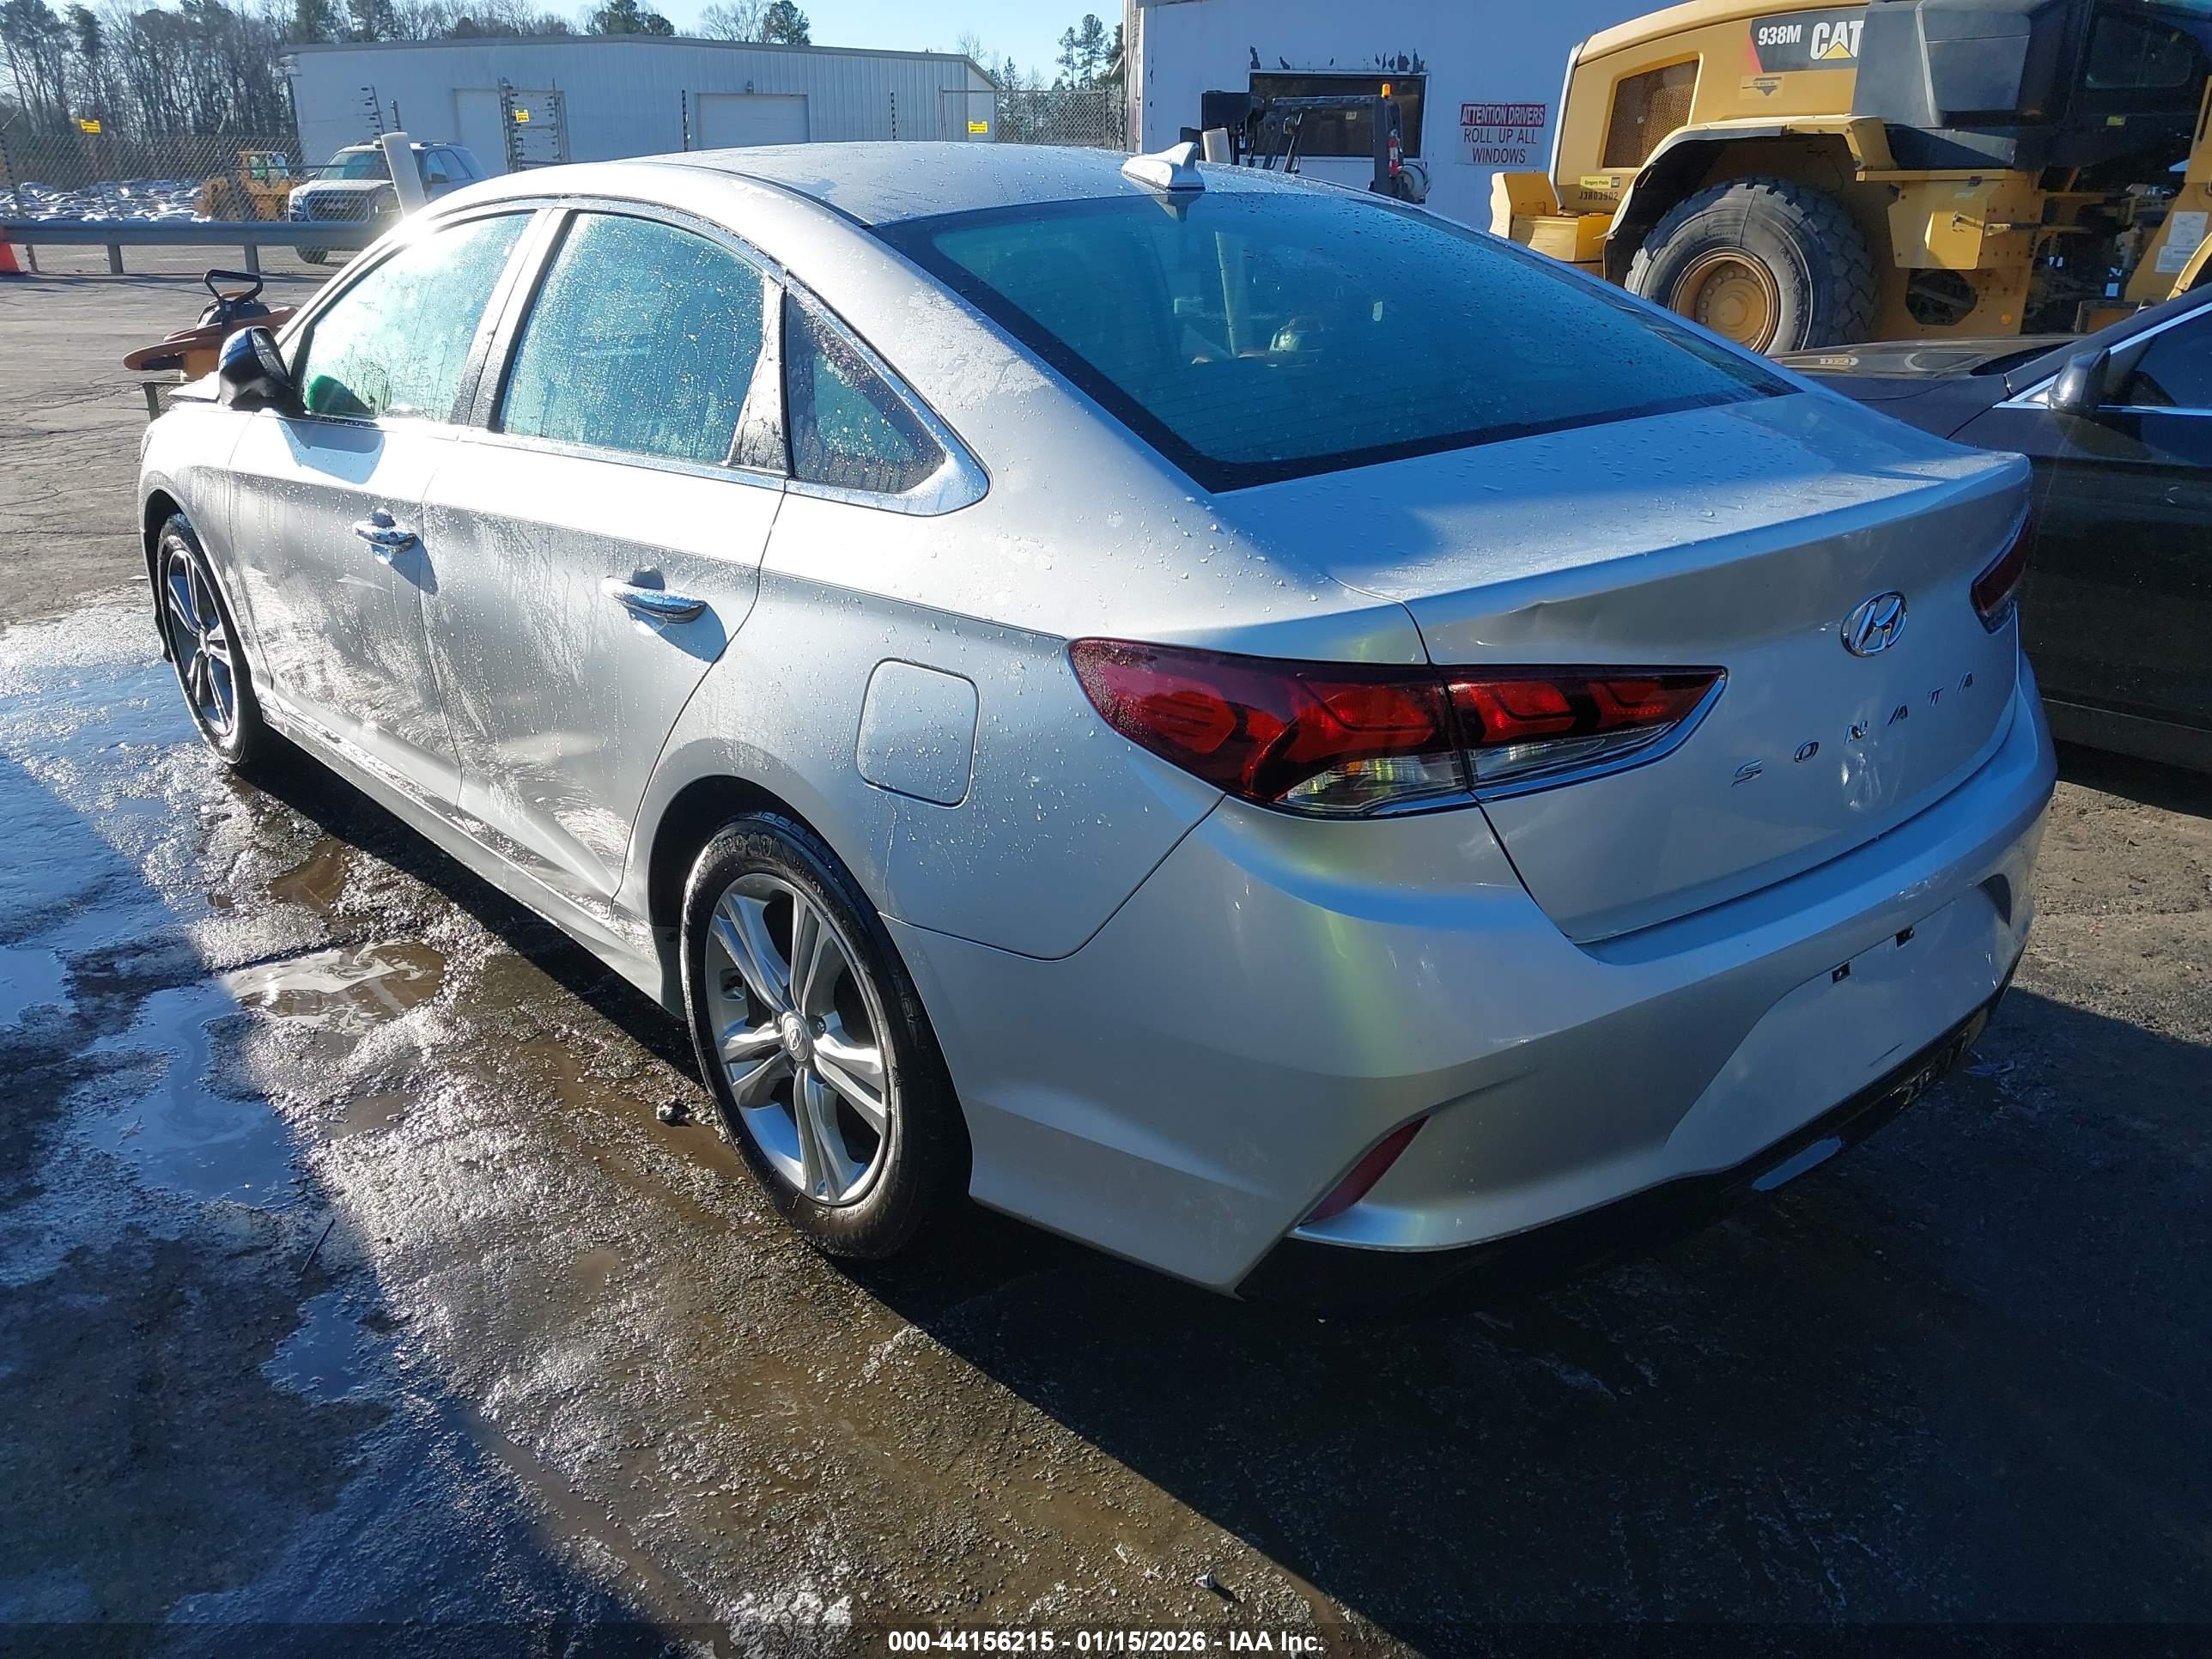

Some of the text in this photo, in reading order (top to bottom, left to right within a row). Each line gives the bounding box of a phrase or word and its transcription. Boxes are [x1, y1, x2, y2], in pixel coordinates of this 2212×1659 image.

[1758, 24, 1802, 46] 938M
[1810, 20, 1865, 60] CAT
[1462, 106, 1544, 125] ATTENTION DRIVERS
[1464, 127, 1537, 144] ROLL UP ALL
[1473, 147, 1526, 164] WINDOWS
[1731, 672, 1973, 787] SONATA
